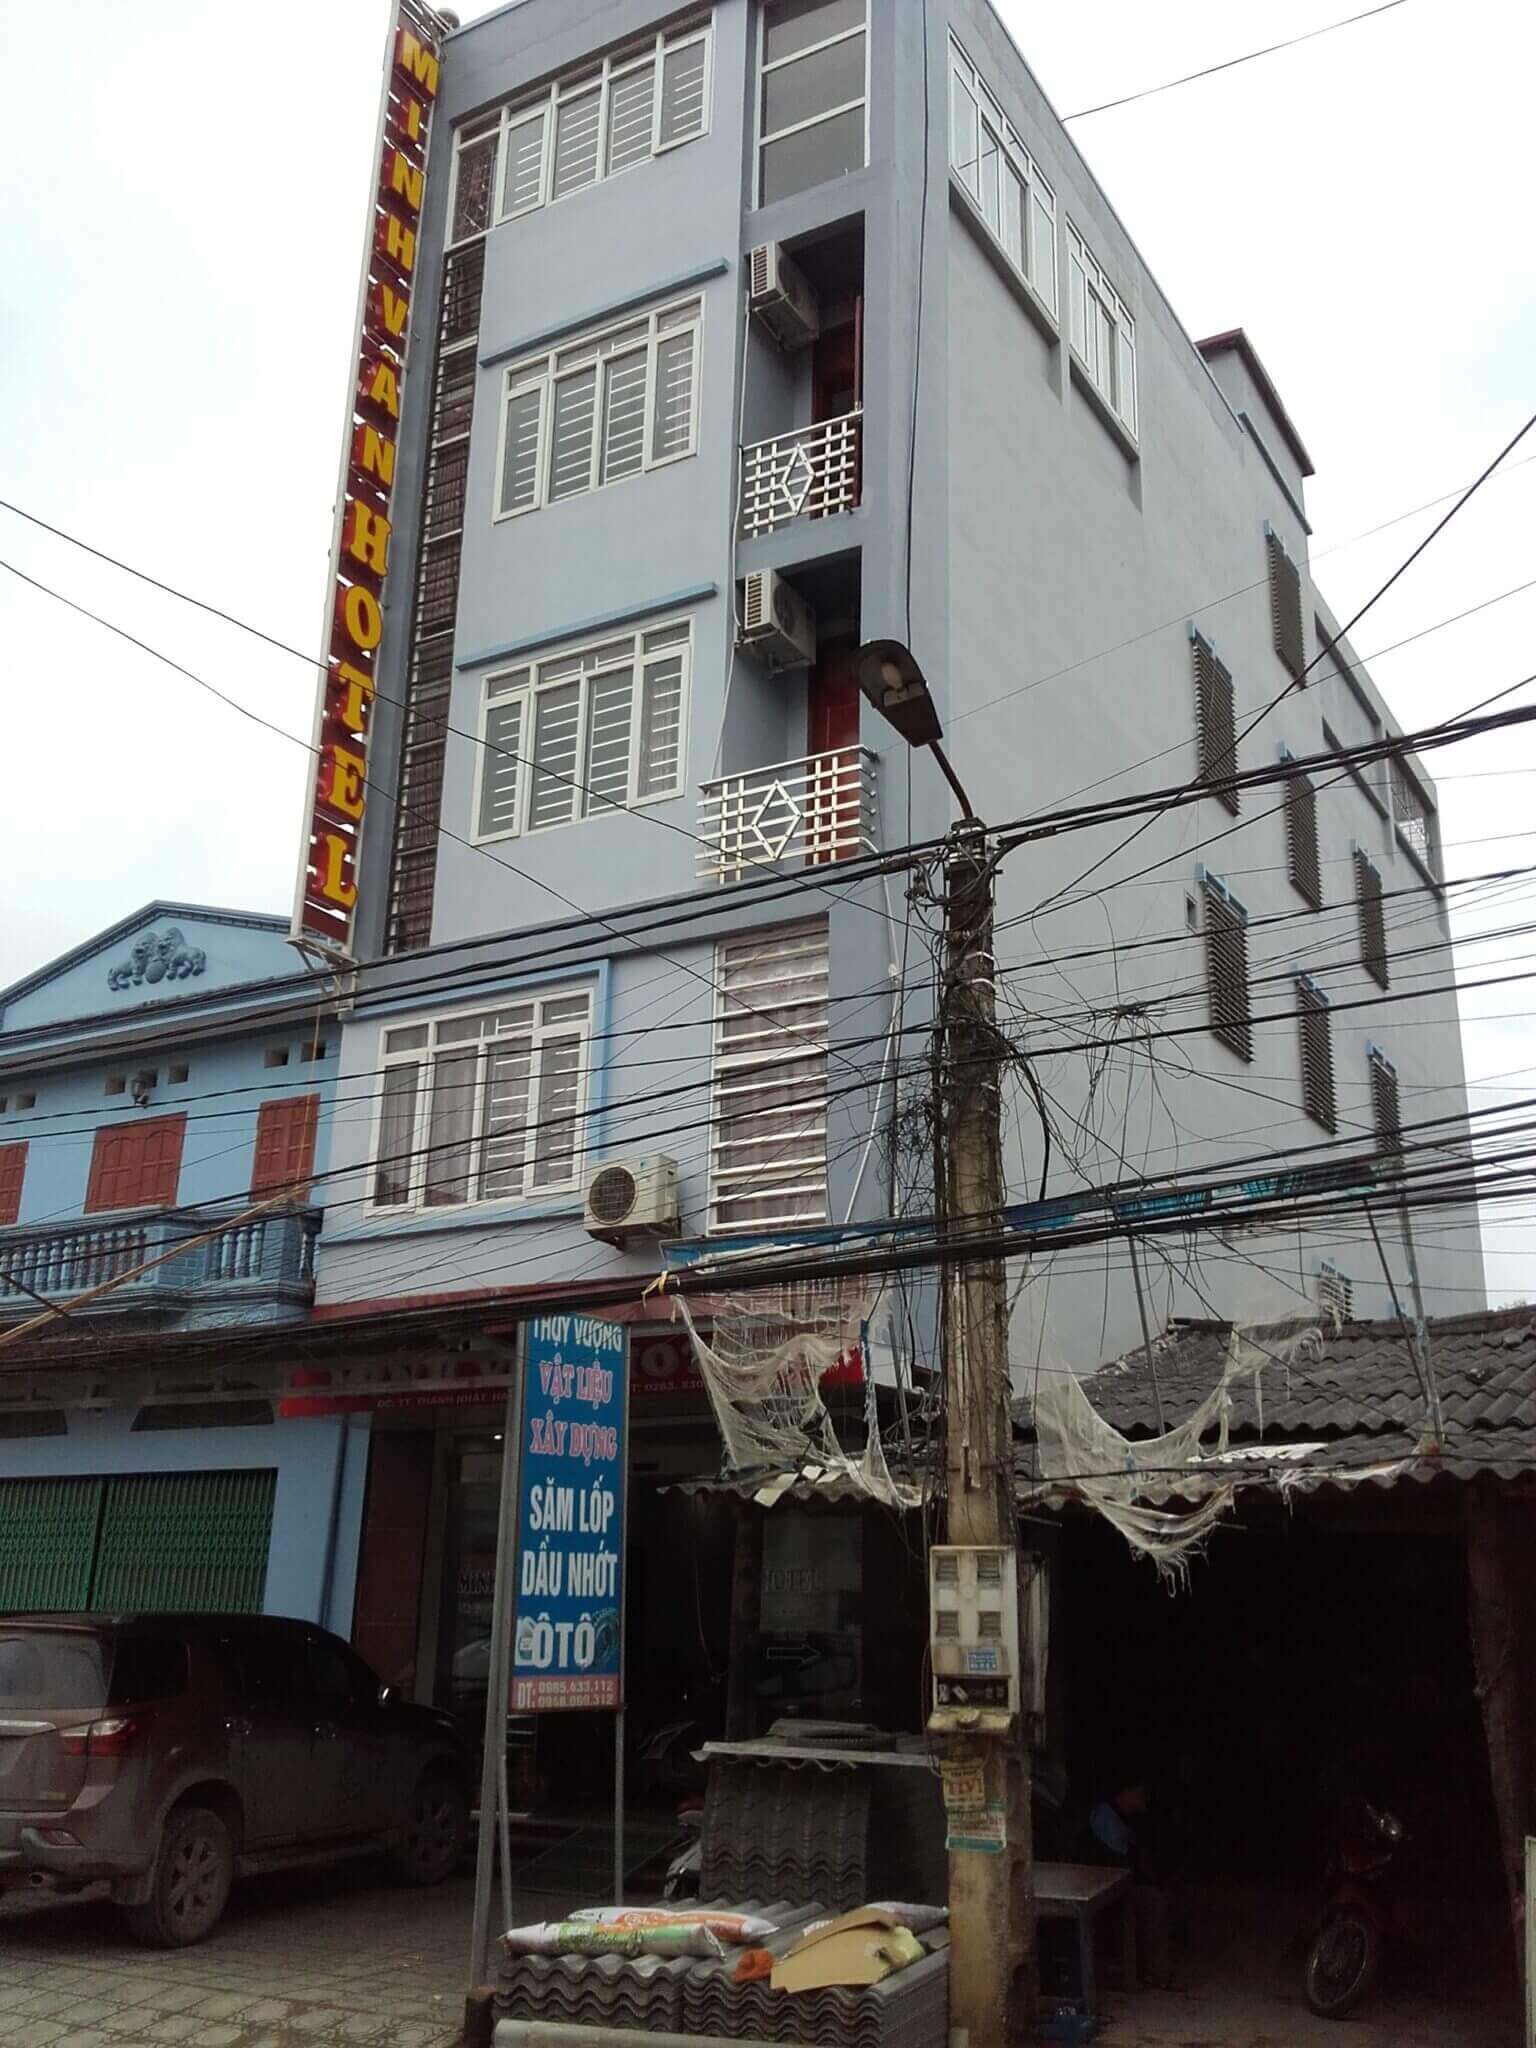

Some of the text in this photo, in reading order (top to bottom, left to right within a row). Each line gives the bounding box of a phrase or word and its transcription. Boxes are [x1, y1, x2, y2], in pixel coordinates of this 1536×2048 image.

[322, 29, 440, 909] MINH VÂN HOTEL
[539, 1352, 575, 1405] VẬT
[576, 1358, 614, 1410] LIỆU
[529, 1409, 619, 1467] XÂY DỰNG
[529, 1471, 615, 1534] SĂM LỐP
[521, 1534, 618, 1598] DẦU NHỚT
